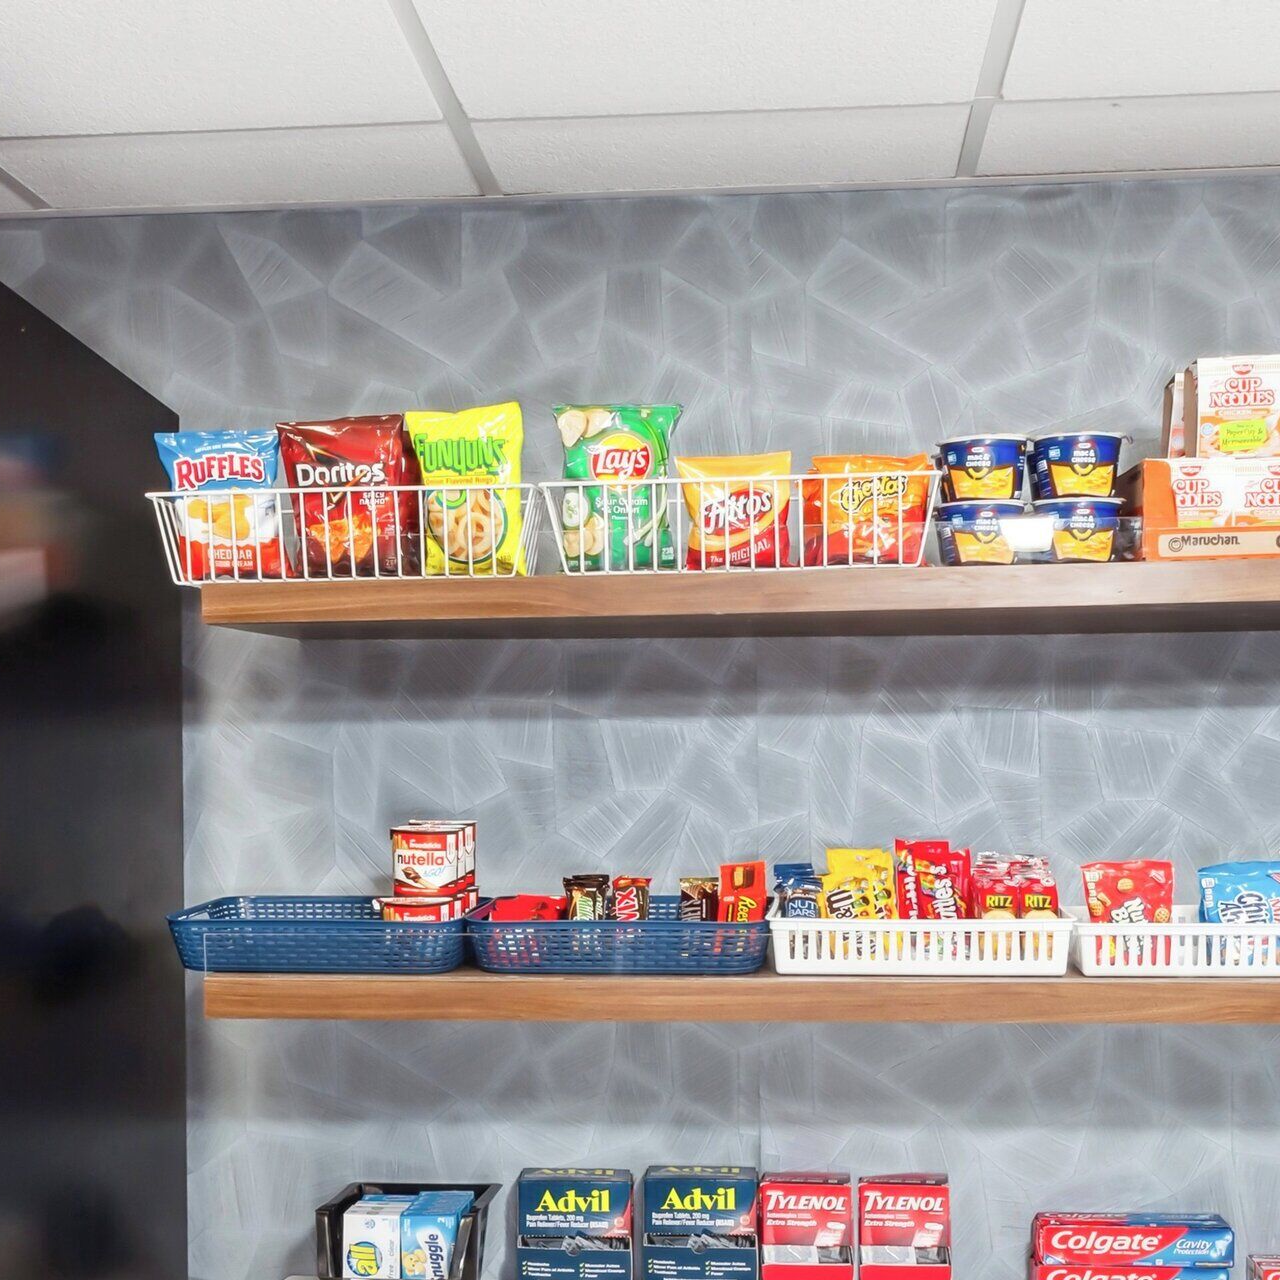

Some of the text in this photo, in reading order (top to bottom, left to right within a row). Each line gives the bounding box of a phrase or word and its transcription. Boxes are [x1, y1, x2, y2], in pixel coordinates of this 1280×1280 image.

[1225, 377, 1262, 392] CUP
[1209, 390, 1275, 407] NOODLES
[414, 434, 507, 475] FUNYUNS
[588, 445, 647, 480] Lay's
[174, 454, 264, 490] RUFFLES
[296, 463, 385, 487] Doritos
[1172, 479, 1210, 495] CUP
[1182, 535, 1240, 546] Maruchan
[398, 853, 444, 865] nutella
[789, 900, 815, 909] NUT
[986, 895, 1014, 908] RITZ
[1025, 895, 1052, 908] RITZ
[789, 909, 815, 917] BARS
[535, 1190, 610, 1212] Advil
[660, 1187, 736, 1211] Advil
[766, 1190, 846, 1211] TYLENOL
[864, 1190, 944, 1211] TYLENOL
[884, 1220, 915, 1228] Strength
[1051, 1230, 1160, 1255] Colgate
[1176, 1239, 1212, 1250] Cavity
[1173, 1248, 1210, 1256] Protection
